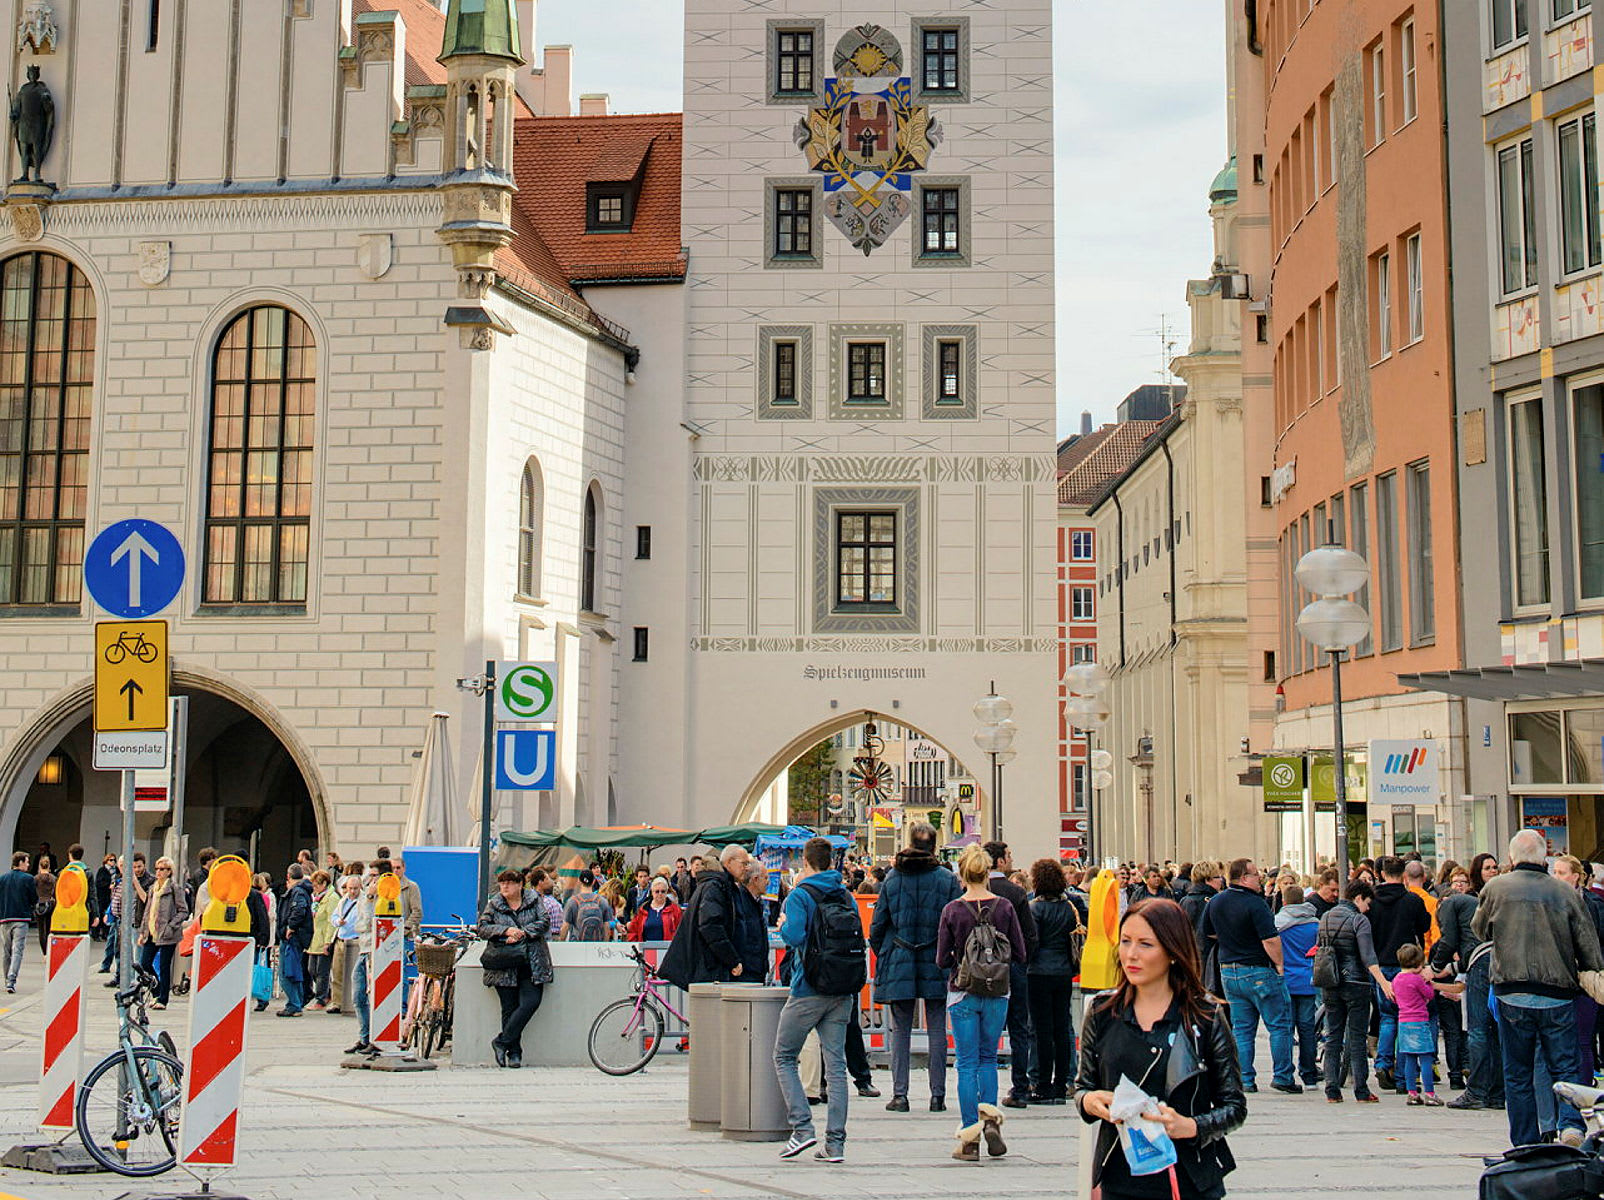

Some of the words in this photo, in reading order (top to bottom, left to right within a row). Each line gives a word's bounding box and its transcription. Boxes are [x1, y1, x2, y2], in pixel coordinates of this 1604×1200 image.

[803, 664, 927, 682] Spielzeugmuseum
[508, 668, 546, 714] S
[100, 743, 162, 755] Odeonsplatz
[504, 733, 548, 786] U
[1380, 783, 1430, 794] Manpower
